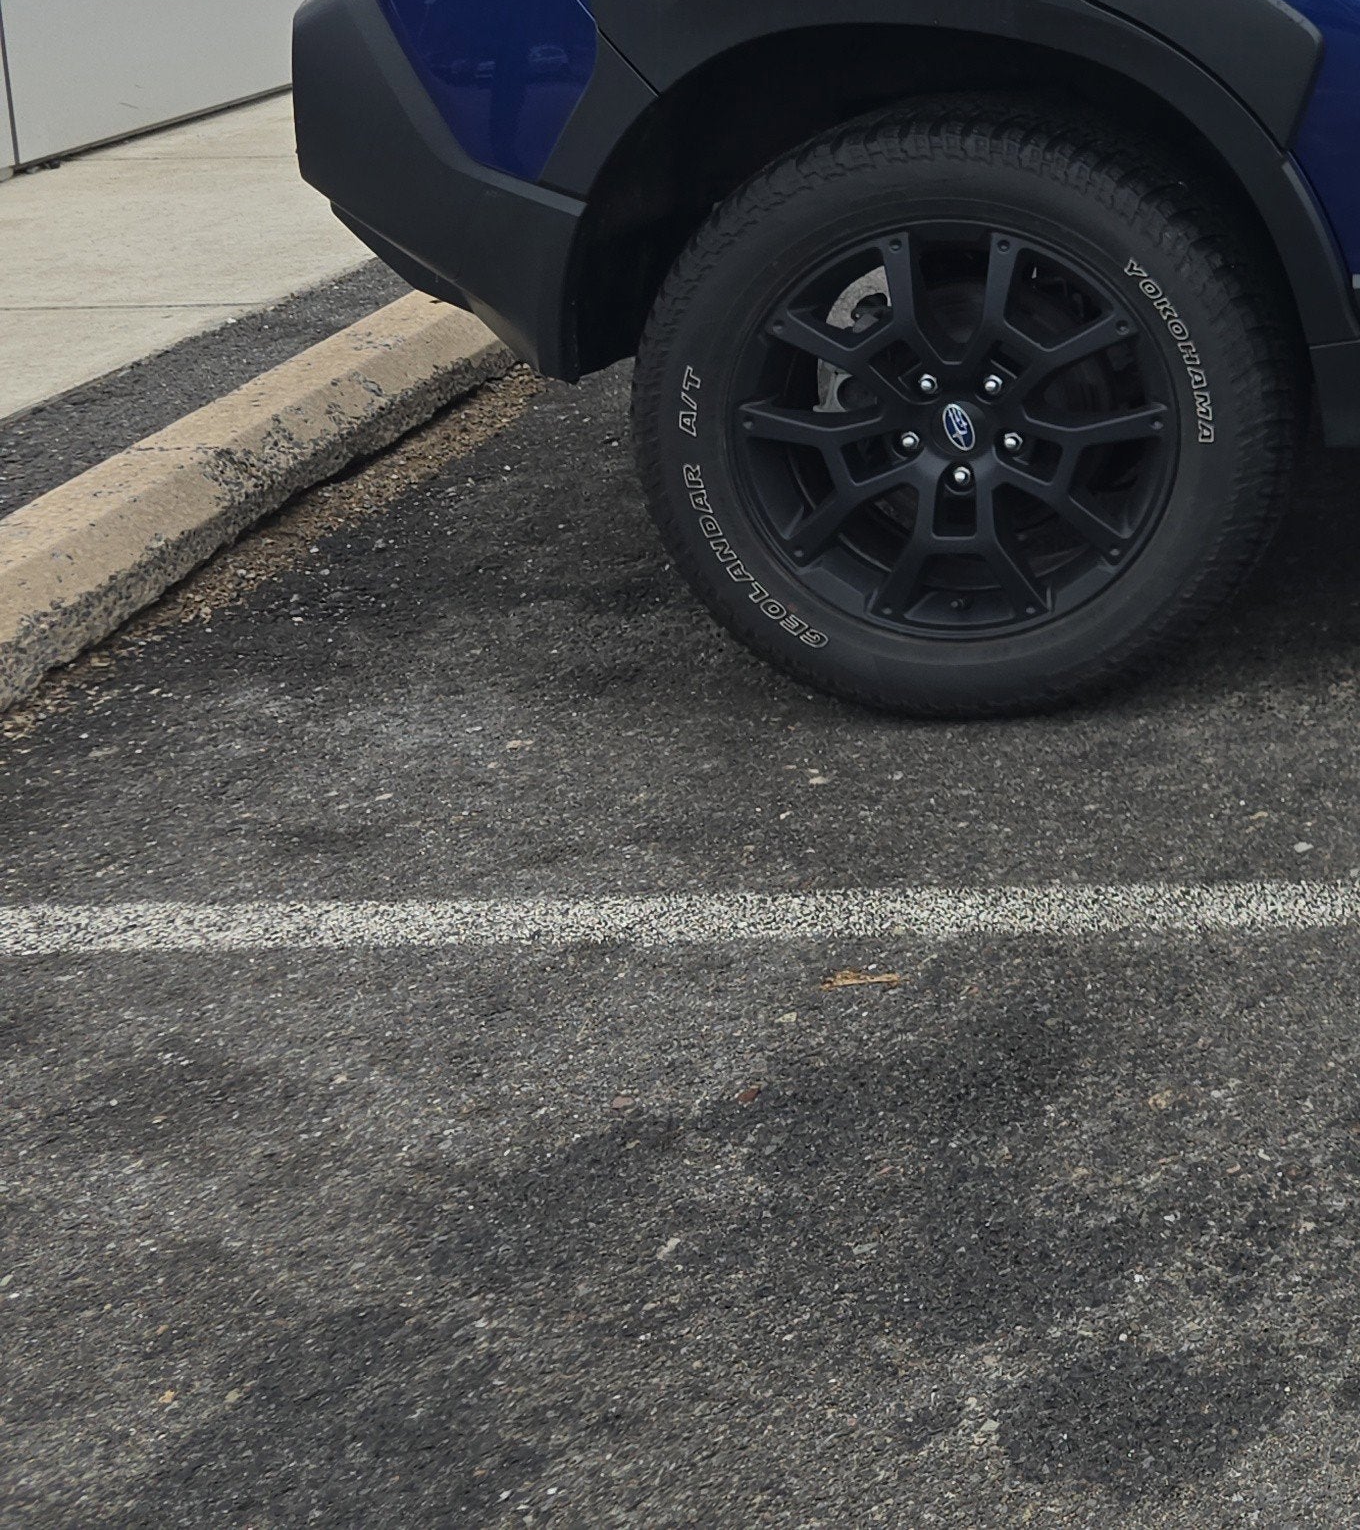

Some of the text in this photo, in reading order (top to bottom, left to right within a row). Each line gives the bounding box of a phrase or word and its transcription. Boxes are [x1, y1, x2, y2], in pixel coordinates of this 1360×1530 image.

[1123, 257, 1215, 444] YOKOHAMA
[678, 365, 829, 649] GEOLANDAR A/T
